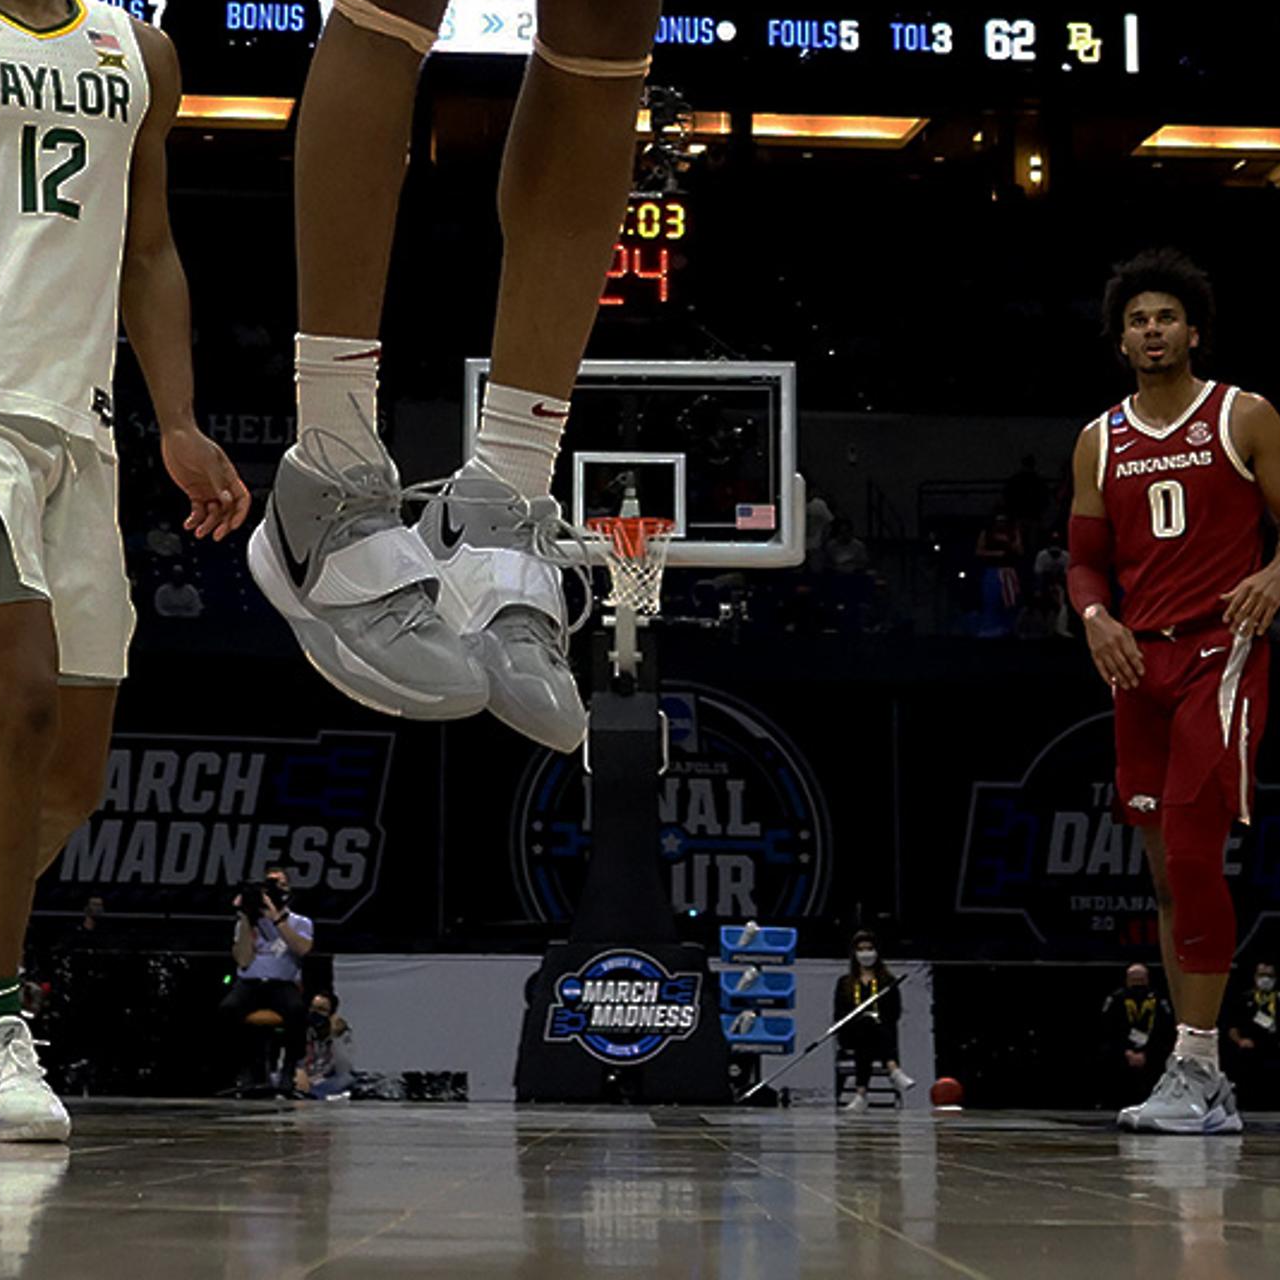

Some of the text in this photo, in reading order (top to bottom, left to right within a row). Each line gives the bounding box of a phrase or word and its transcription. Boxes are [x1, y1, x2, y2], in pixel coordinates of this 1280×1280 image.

[226, 1, 305, 32] BONUS
[654, 16, 715, 44] ONUS
[984, 18, 1037, 61] 62
[19, 123, 87, 220] 12
[1115, 450, 1213, 479] ARKANSAS
[1147, 477, 1187, 540] 0
[98, 748, 266, 816] ARCH
[58, 819, 372, 890] MADNESS
[1046, 810, 1244, 877] DAE
[581, 980, 659, 1003] MARCH
[591, 1004, 694, 1028] MADNESS
